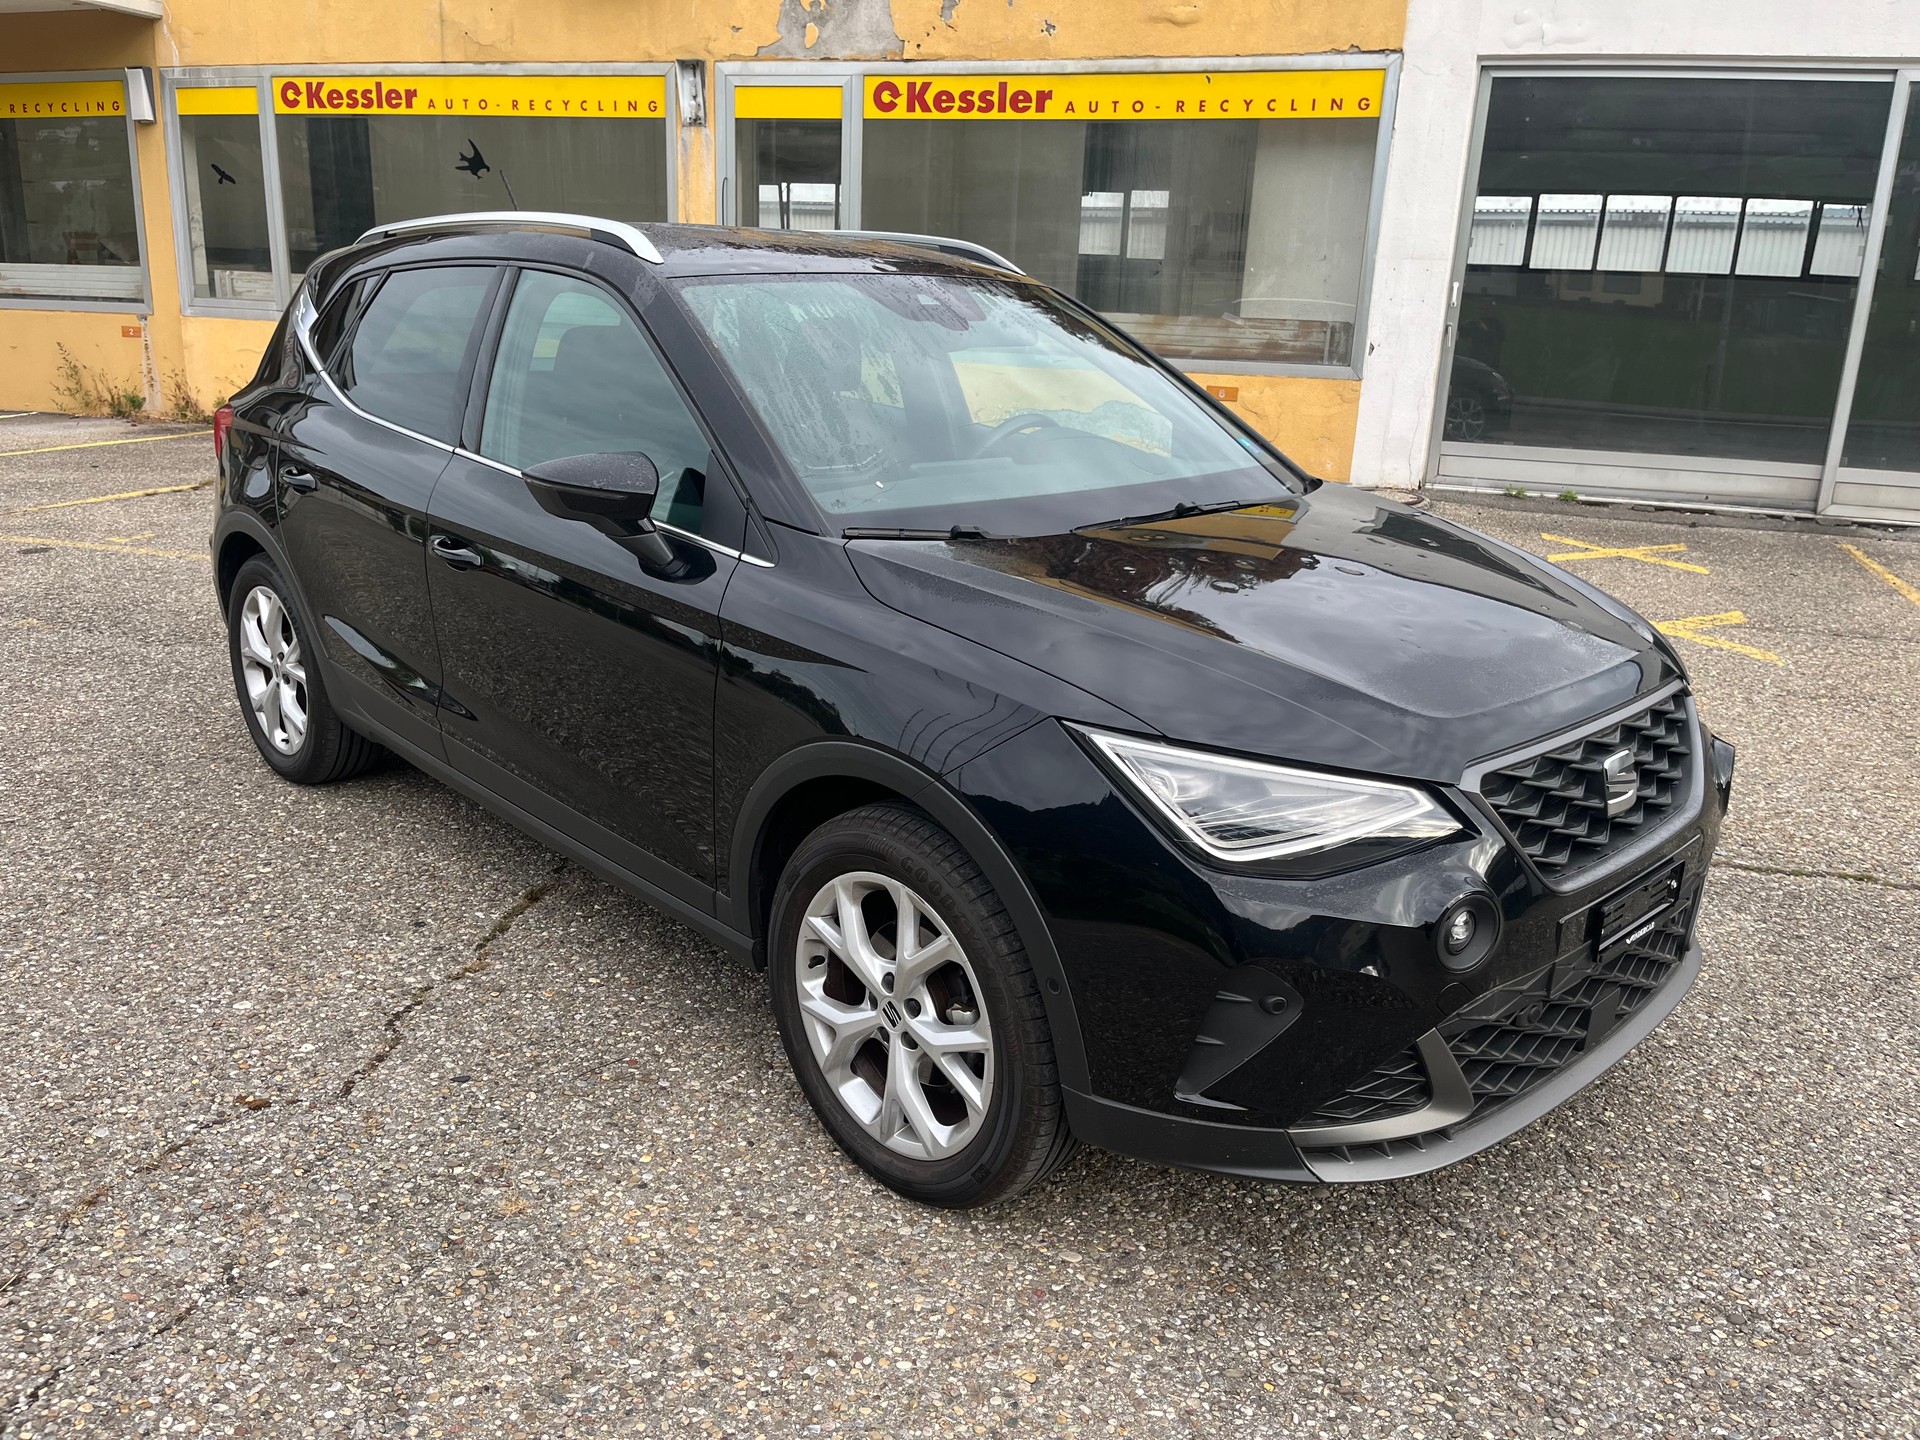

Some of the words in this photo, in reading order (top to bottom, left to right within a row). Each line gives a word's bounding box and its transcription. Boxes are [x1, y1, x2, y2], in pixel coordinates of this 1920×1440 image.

[305, 81, 418, 110] Kessler
[906, 81, 1053, 114] Kessler
[128, 328, 134, 336] 2
[1218, 389, 1226, 398] 6
